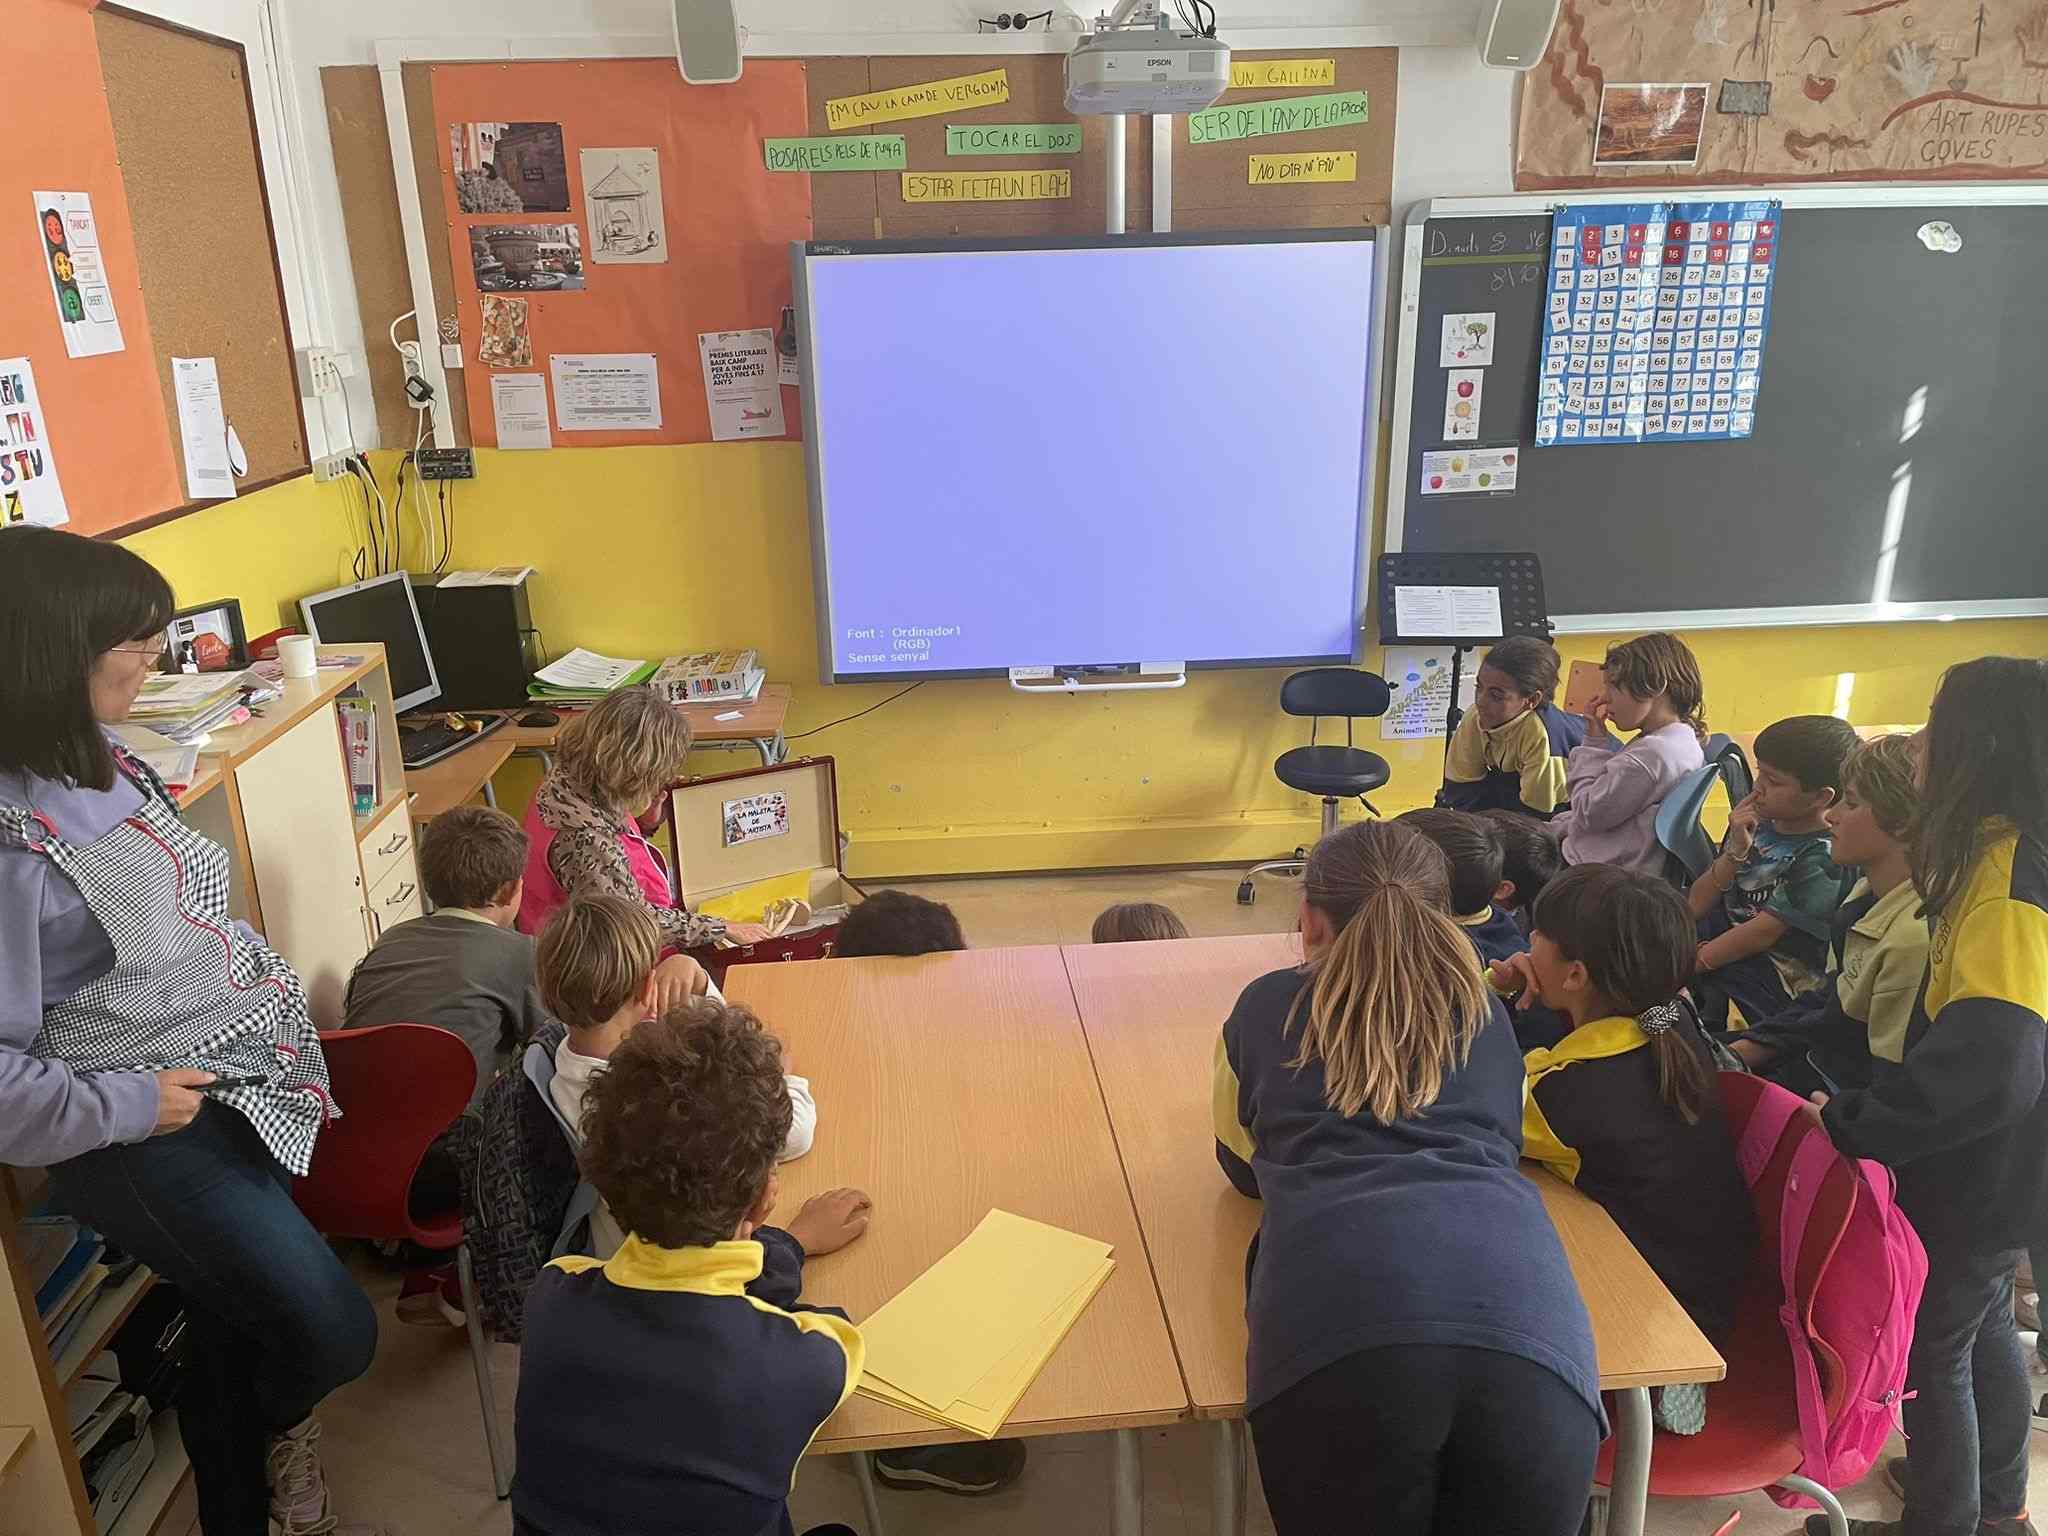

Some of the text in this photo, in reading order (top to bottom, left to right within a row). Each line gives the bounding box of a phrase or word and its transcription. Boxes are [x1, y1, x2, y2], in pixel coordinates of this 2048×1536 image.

[1148, 59, 1172, 67] EPSON
[1233, 70, 1255, 86] UN
[1191, 111, 1230, 142] SER
[1237, 110, 1259, 138] DE
[1304, 107, 1323, 128] DE
[1324, 103, 1338, 124] LA
[1921, 101, 1974, 135] ART
[952, 130, 1074, 149] TOCAR EL DOS
[860, 142, 871, 158] DE
[1921, 138, 1997, 162] COVES
[1256, 163, 1274, 182] NO
[908, 176, 954, 198] ESTAR
[1562, 254, 1569, 262] 11
[1587, 250, 1596, 258] 12
[1607, 251, 1617, 259] 13
[1628, 251, 1637, 259] 14
[1668, 250, 1679, 259] 16
[1712, 249, 1722, 257] 18
[1755, 248, 1767, 256] 20
[1561, 275, 1570, 283] 21
[1604, 273, 1616, 281] 23
[1665, 272, 1678, 280] 26
[1555, 297, 1565, 305] 31
[1602, 296, 1614, 304] 33
[1557, 316, 1566, 324] 41
[1599, 317, 1610, 325] 43
[1661, 315, 1673, 323] 46
[1680, 335, 1692, 343] 57
[1702, 335, 1714, 343] 58
[1723, 335, 1735, 343] 59
[1746, 334, 1759, 342] 60
[709, 351, 734, 359] PREMIS
[1551, 361, 1561, 369] 61
[1573, 360, 1584, 368] 62
[1594, 360, 1605, 368] 63
[1677, 357, 1689, 365] 67
[1700, 356, 1711, 364] 68
[1720, 356, 1732, 364] 69
[1572, 382, 1582, 390] 72
[1676, 378, 1688, 386] 77
[1696, 378, 1707, 386] 78
[1719, 377, 1730, 385] 79
[1570, 400, 1580, 408] 82
[1589, 402, 1600, 410] 83
[1651, 400, 1663, 408] 86
[1674, 399, 1684, 407] 87
[1717, 398, 1728, 406] 89
[1566, 424, 1577, 432] 92
[1588, 424, 1599, 432] 93
[1649, 421, 1661, 429] 96
[1671, 420, 1682, 428] 97
[1714, 419, 1725, 427] 99
[847, 629, 875, 639] Font
[892, 625, 961, 638] Ordinador1
[893, 639, 931, 650] (RGB)
[848, 651, 929, 663] Sense senyal
